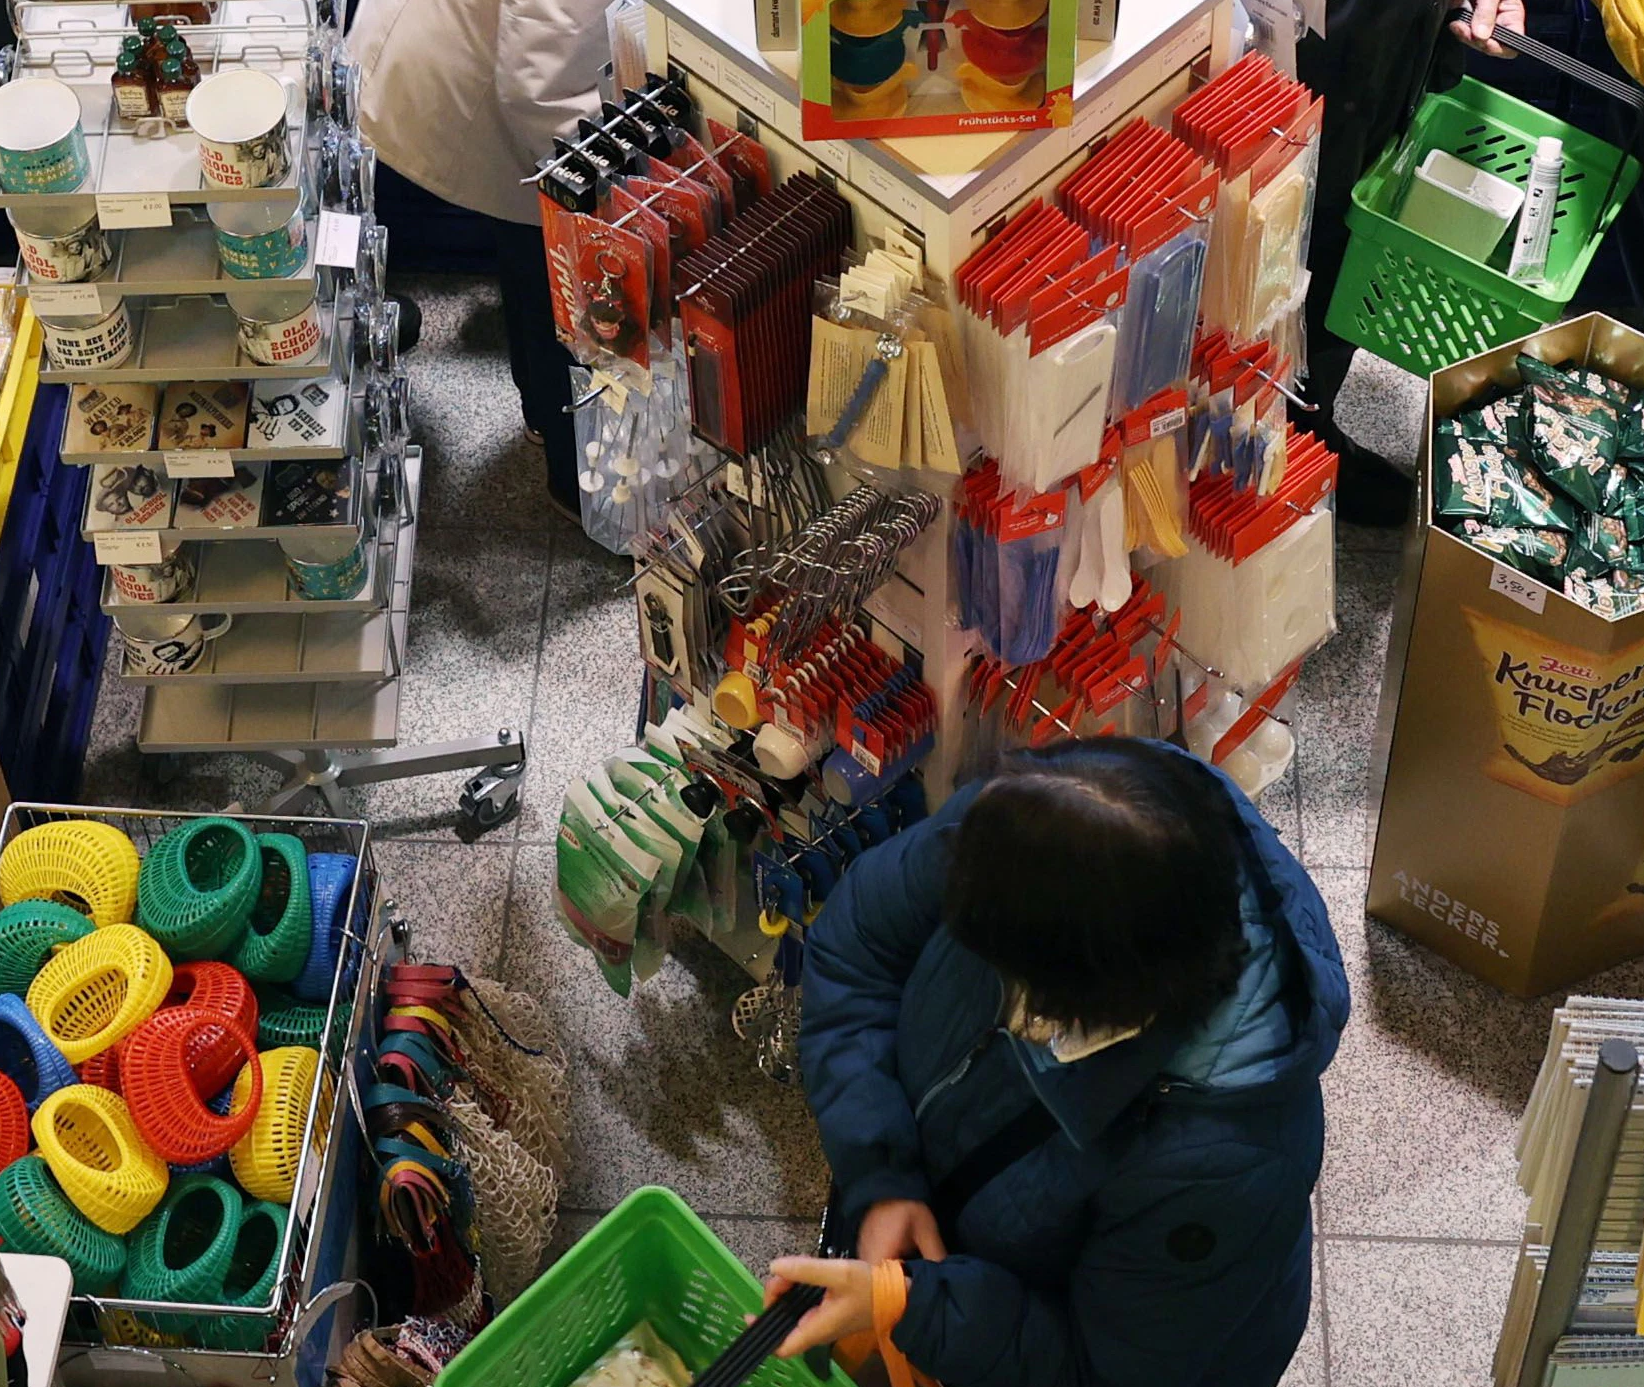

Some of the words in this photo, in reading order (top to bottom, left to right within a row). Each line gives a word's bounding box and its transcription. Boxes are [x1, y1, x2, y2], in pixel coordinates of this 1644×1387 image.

[957, 113, 1038, 127] Frühstücks-Set
[270, 323, 319, 353] SCHOOL
[283, 318, 309, 338] OLD
[271, 332, 321, 362] HEROES
[83, 396, 123, 427] WANTED
[124, 510, 140, 526] OLD
[1538, 654, 1602, 682] Zetti
[1391, 868, 1501, 938] ANDERS
